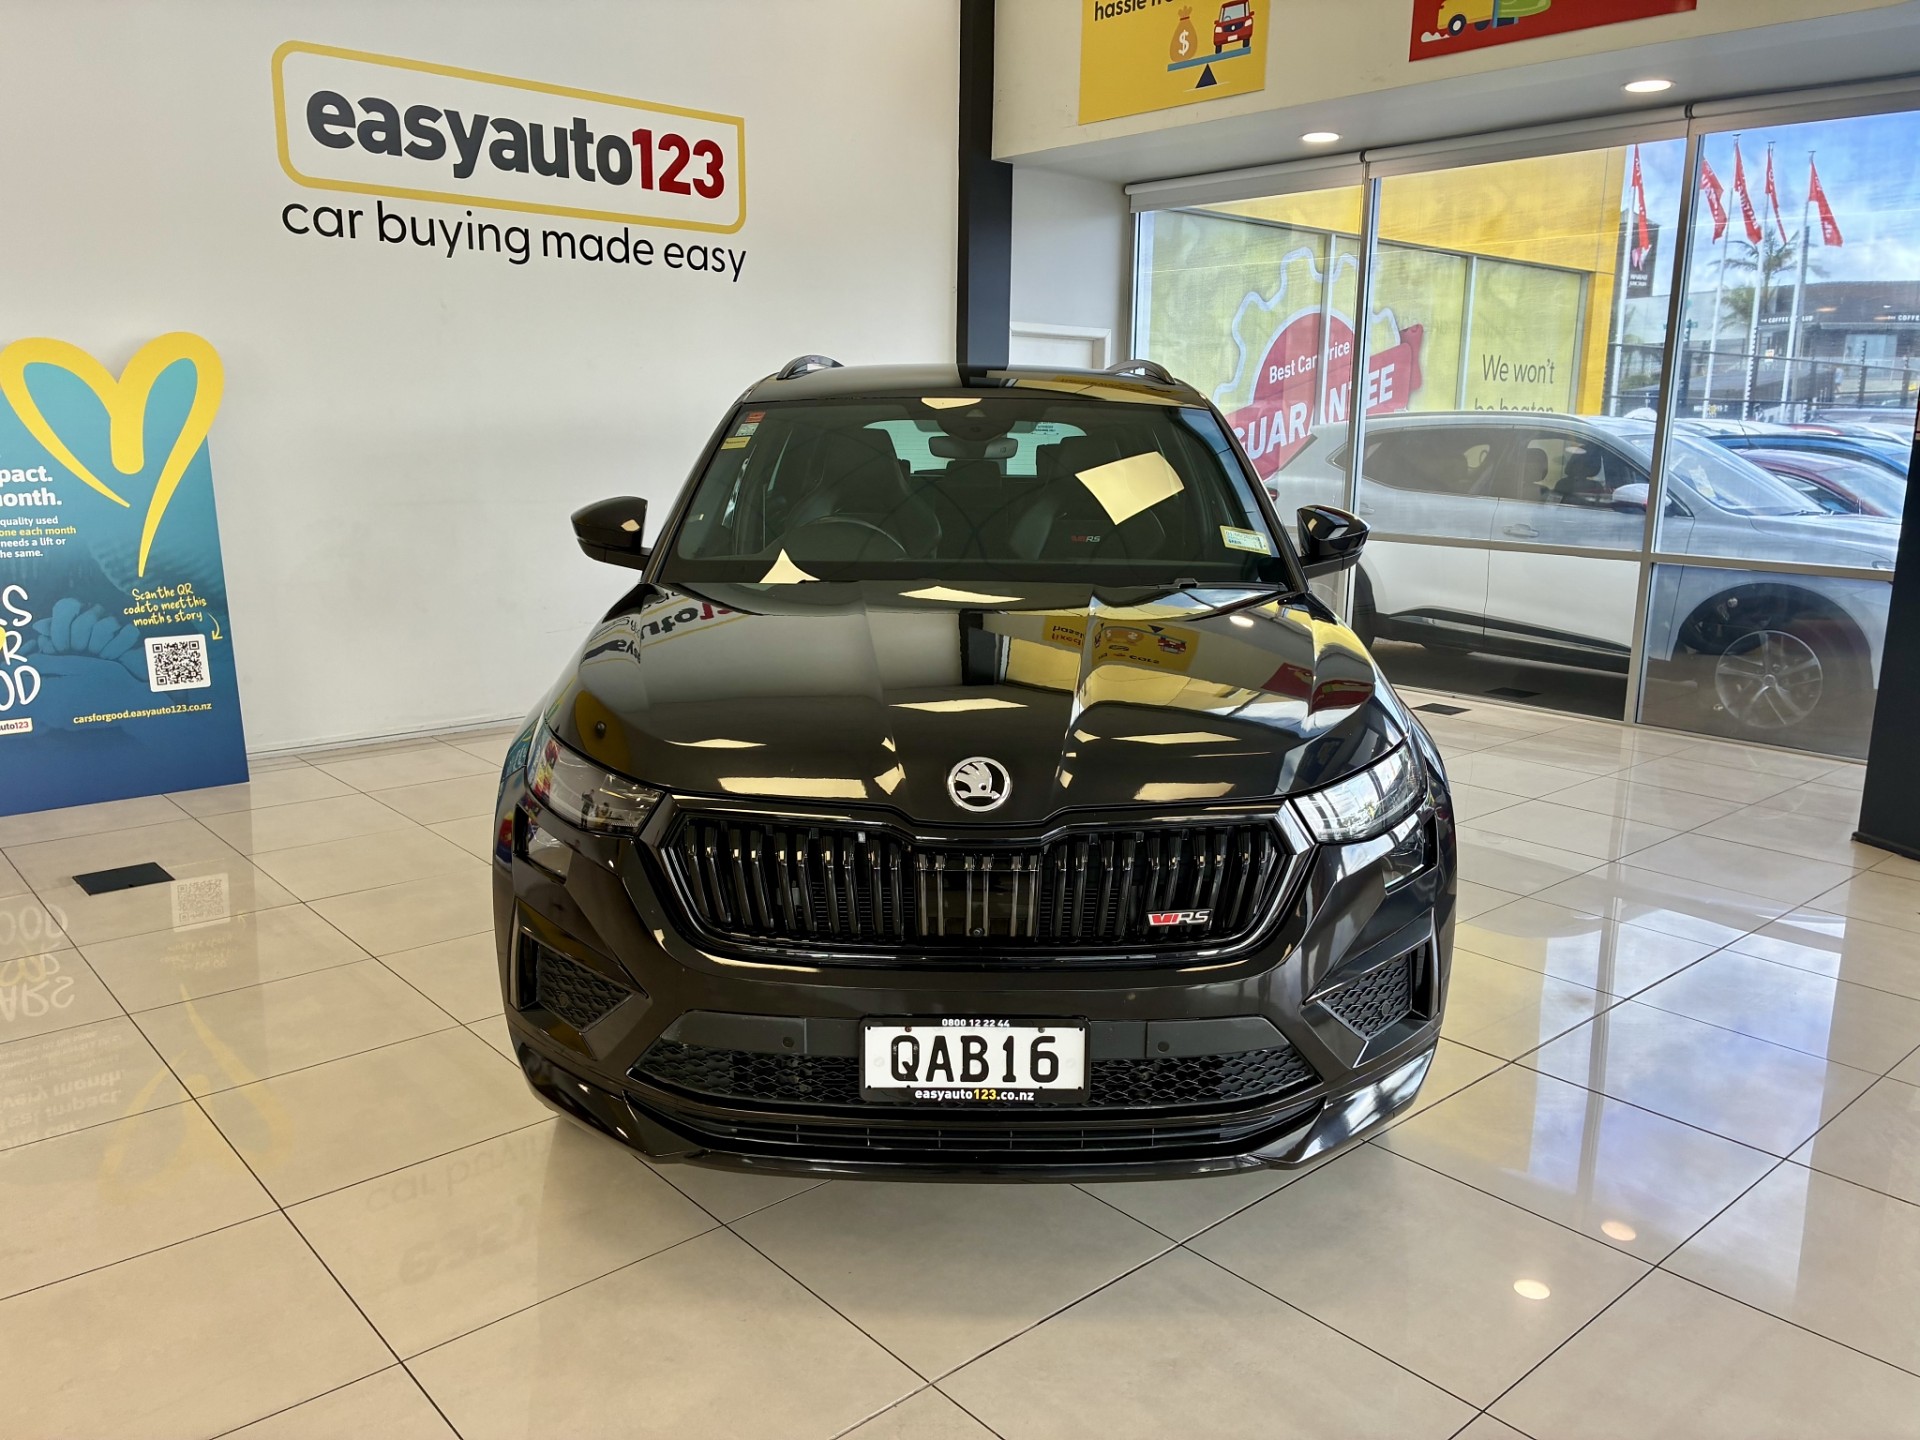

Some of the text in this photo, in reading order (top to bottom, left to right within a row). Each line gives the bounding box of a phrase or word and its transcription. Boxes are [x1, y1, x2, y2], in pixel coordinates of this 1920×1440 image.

[306, 90, 724, 199] easyauto123
[281, 200, 747, 283] car buying made easy
[1269, 359, 1296, 385] Best
[1298, 354, 1318, 374] Car
[1482, 354, 1509, 383] We
[0, 487, 62, 507] onth.
[0, 515, 59, 528] quality used
[19, 527, 43, 536] each
[45, 525, 77, 535] month
[0, 538, 30, 548] needs
[40, 536, 54, 546] lift
[55, 538, 67, 546] or
[15, 549, 44, 558] same.
[132, 582, 194, 601] Scan the QR
[123, 595, 208, 615] code to meet this
[133, 608, 203, 627] month's story
[73, 702, 213, 724] carsforgood.easyauto123.co.nz
[0, 720, 29, 733] uto123
[942, 1018, 1010, 1028] 0800 12 22 44
[890, 1034, 1060, 1083] QAB16
[914, 1088, 1035, 1101] easyauto123.co.nz
